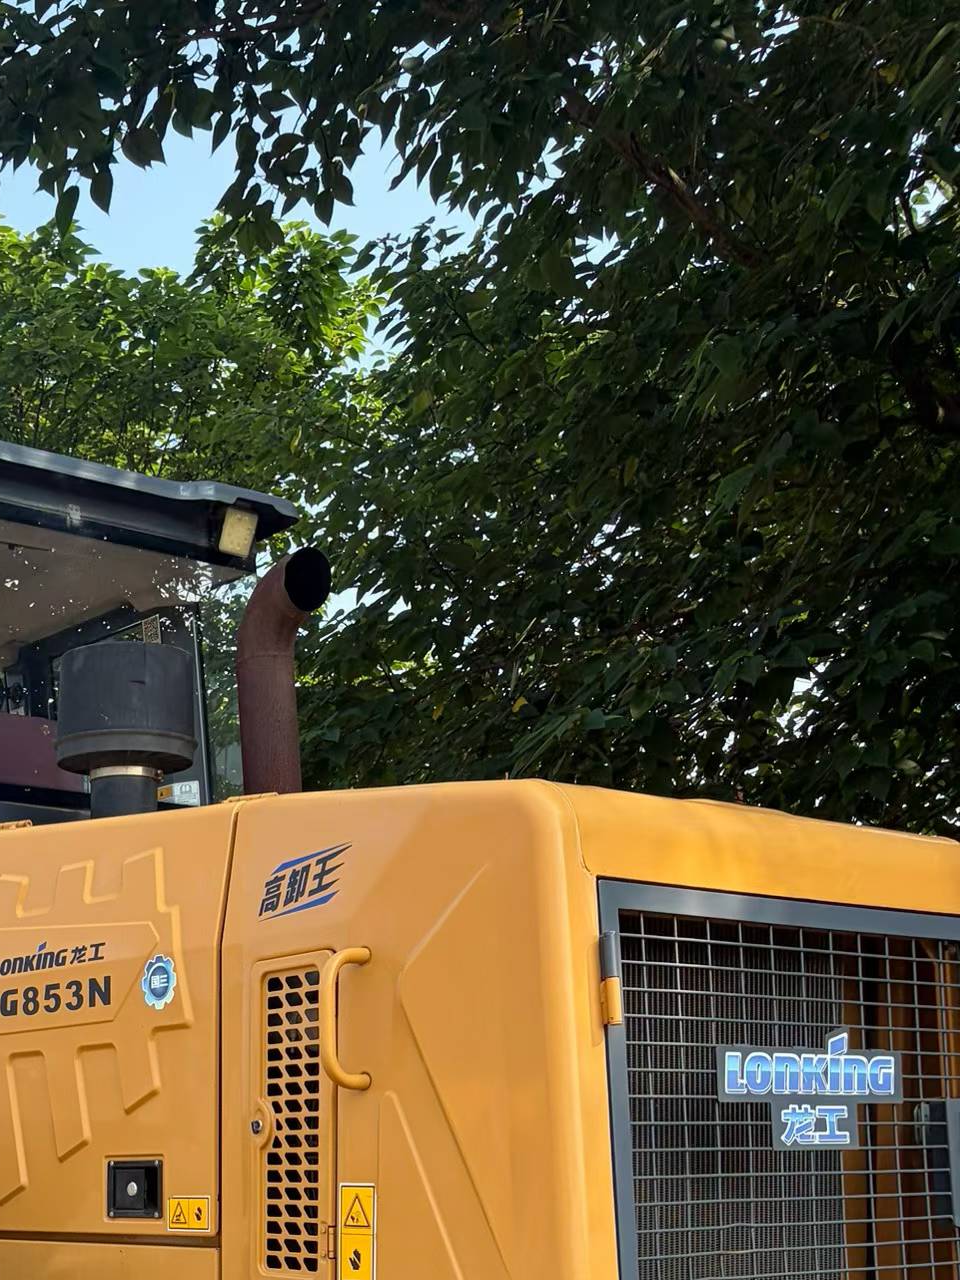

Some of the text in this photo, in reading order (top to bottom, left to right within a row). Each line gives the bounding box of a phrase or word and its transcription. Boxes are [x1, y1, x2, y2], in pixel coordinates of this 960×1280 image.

[258, 844, 352, 917] 高卸王
[69, 942, 106, 965] 龙工
[780, 1104, 850, 1146] 龙工
